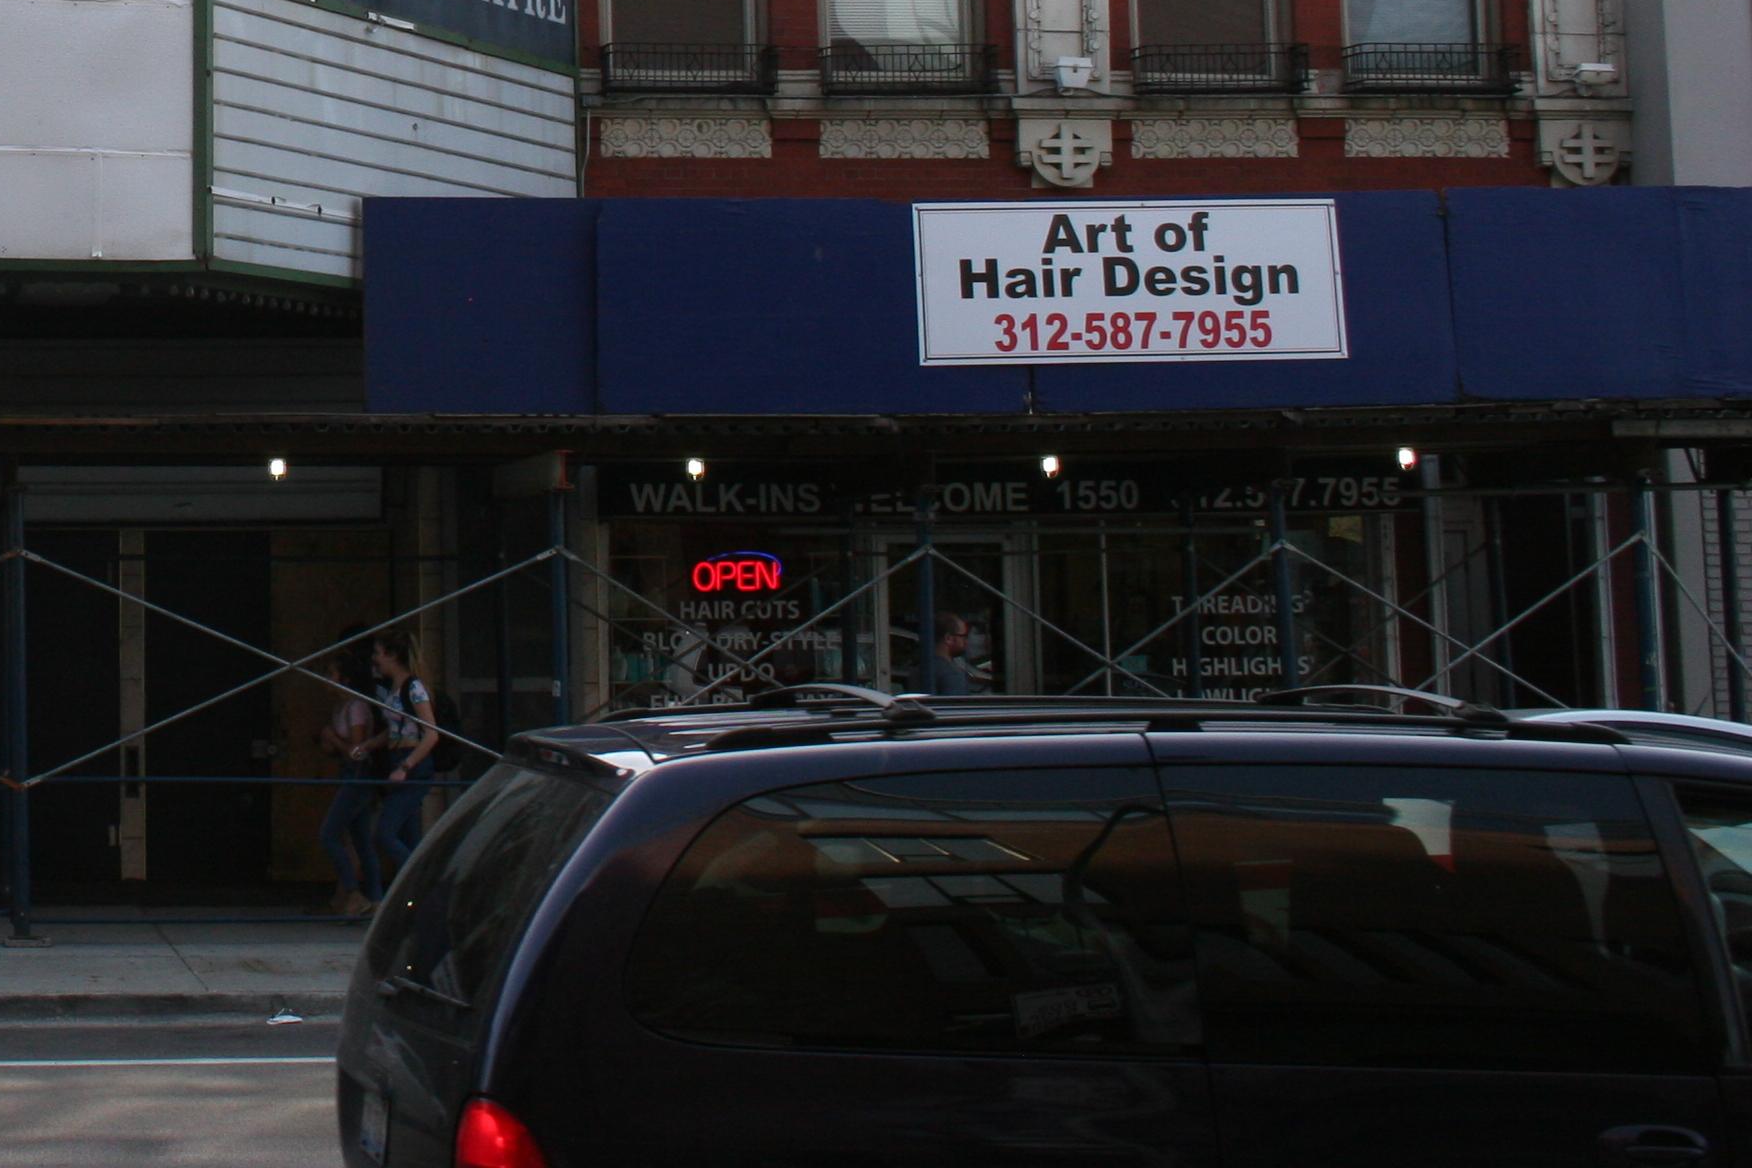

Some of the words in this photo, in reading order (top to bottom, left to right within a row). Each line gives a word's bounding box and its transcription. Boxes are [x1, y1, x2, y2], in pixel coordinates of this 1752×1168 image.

[1043, 213, 1134, 254] Art
[1153, 211, 1210, 252] of
[959, 257, 1083, 299] Hair
[1101, 255, 1300, 306] Design
[993, 310, 1274, 352] 312-587-7955
[629, 482, 822, 513] WALK-INS
[1056, 479, 1140, 510] 1550
[692, 560, 782, 592] OPEN
[680, 599, 736, 620] HAIR
[740, 599, 801, 620] CUTS
[1201, 625, 1279, 646] COLOR
